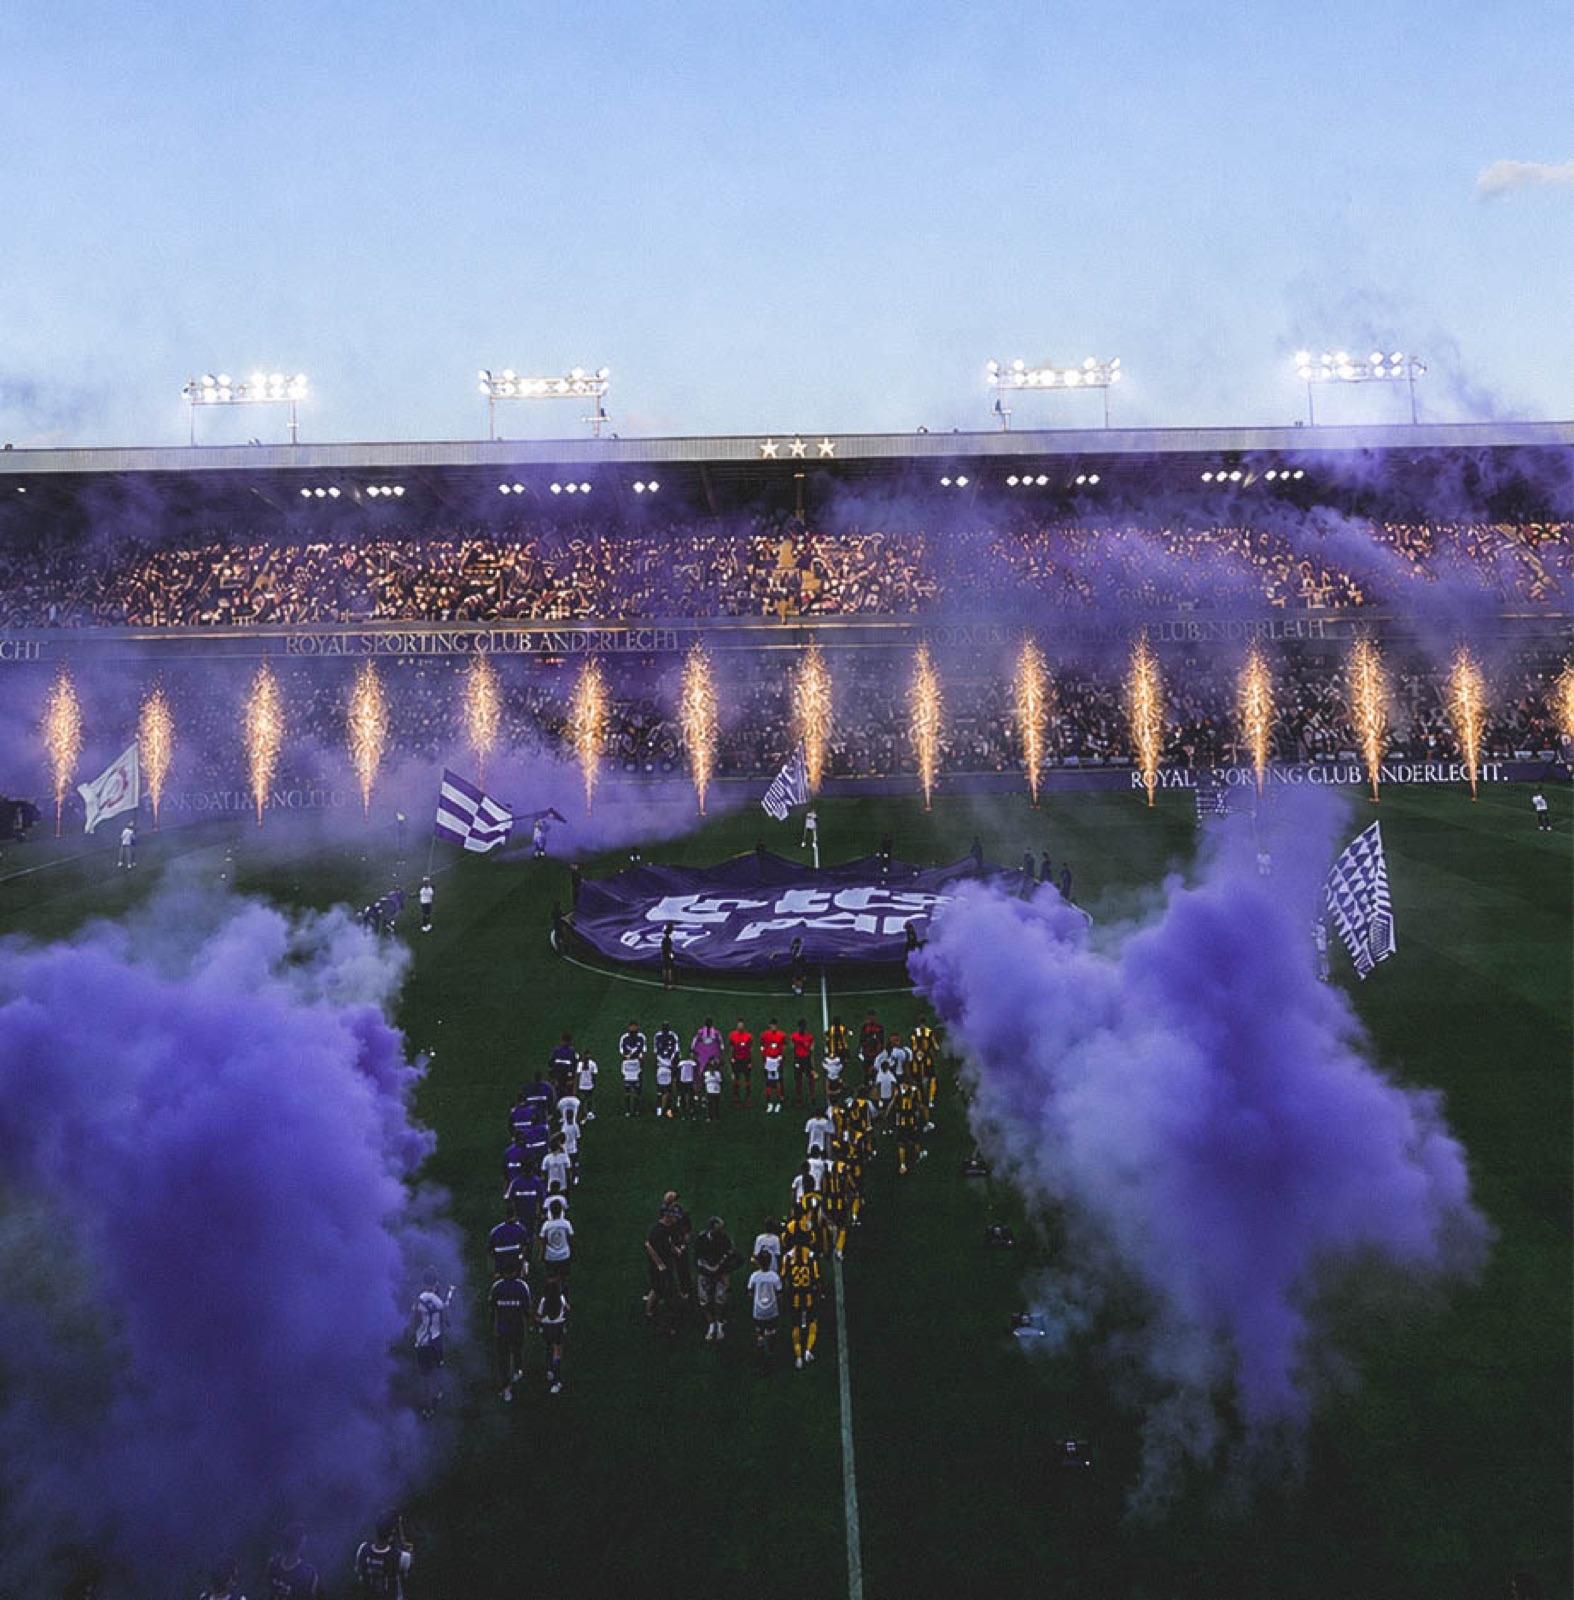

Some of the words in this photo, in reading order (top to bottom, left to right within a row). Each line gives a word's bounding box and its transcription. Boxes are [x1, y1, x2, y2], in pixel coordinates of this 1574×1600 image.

[286, 634, 353, 654] ROYAL
[361, 632, 468, 653] SPORTING
[475, 630, 532, 651] CLUB
[1131, 769, 1197, 788] ROYAL
[1308, 767, 1361, 784] CLUB
[1367, 763, 1508, 783] NDERLECHT.
